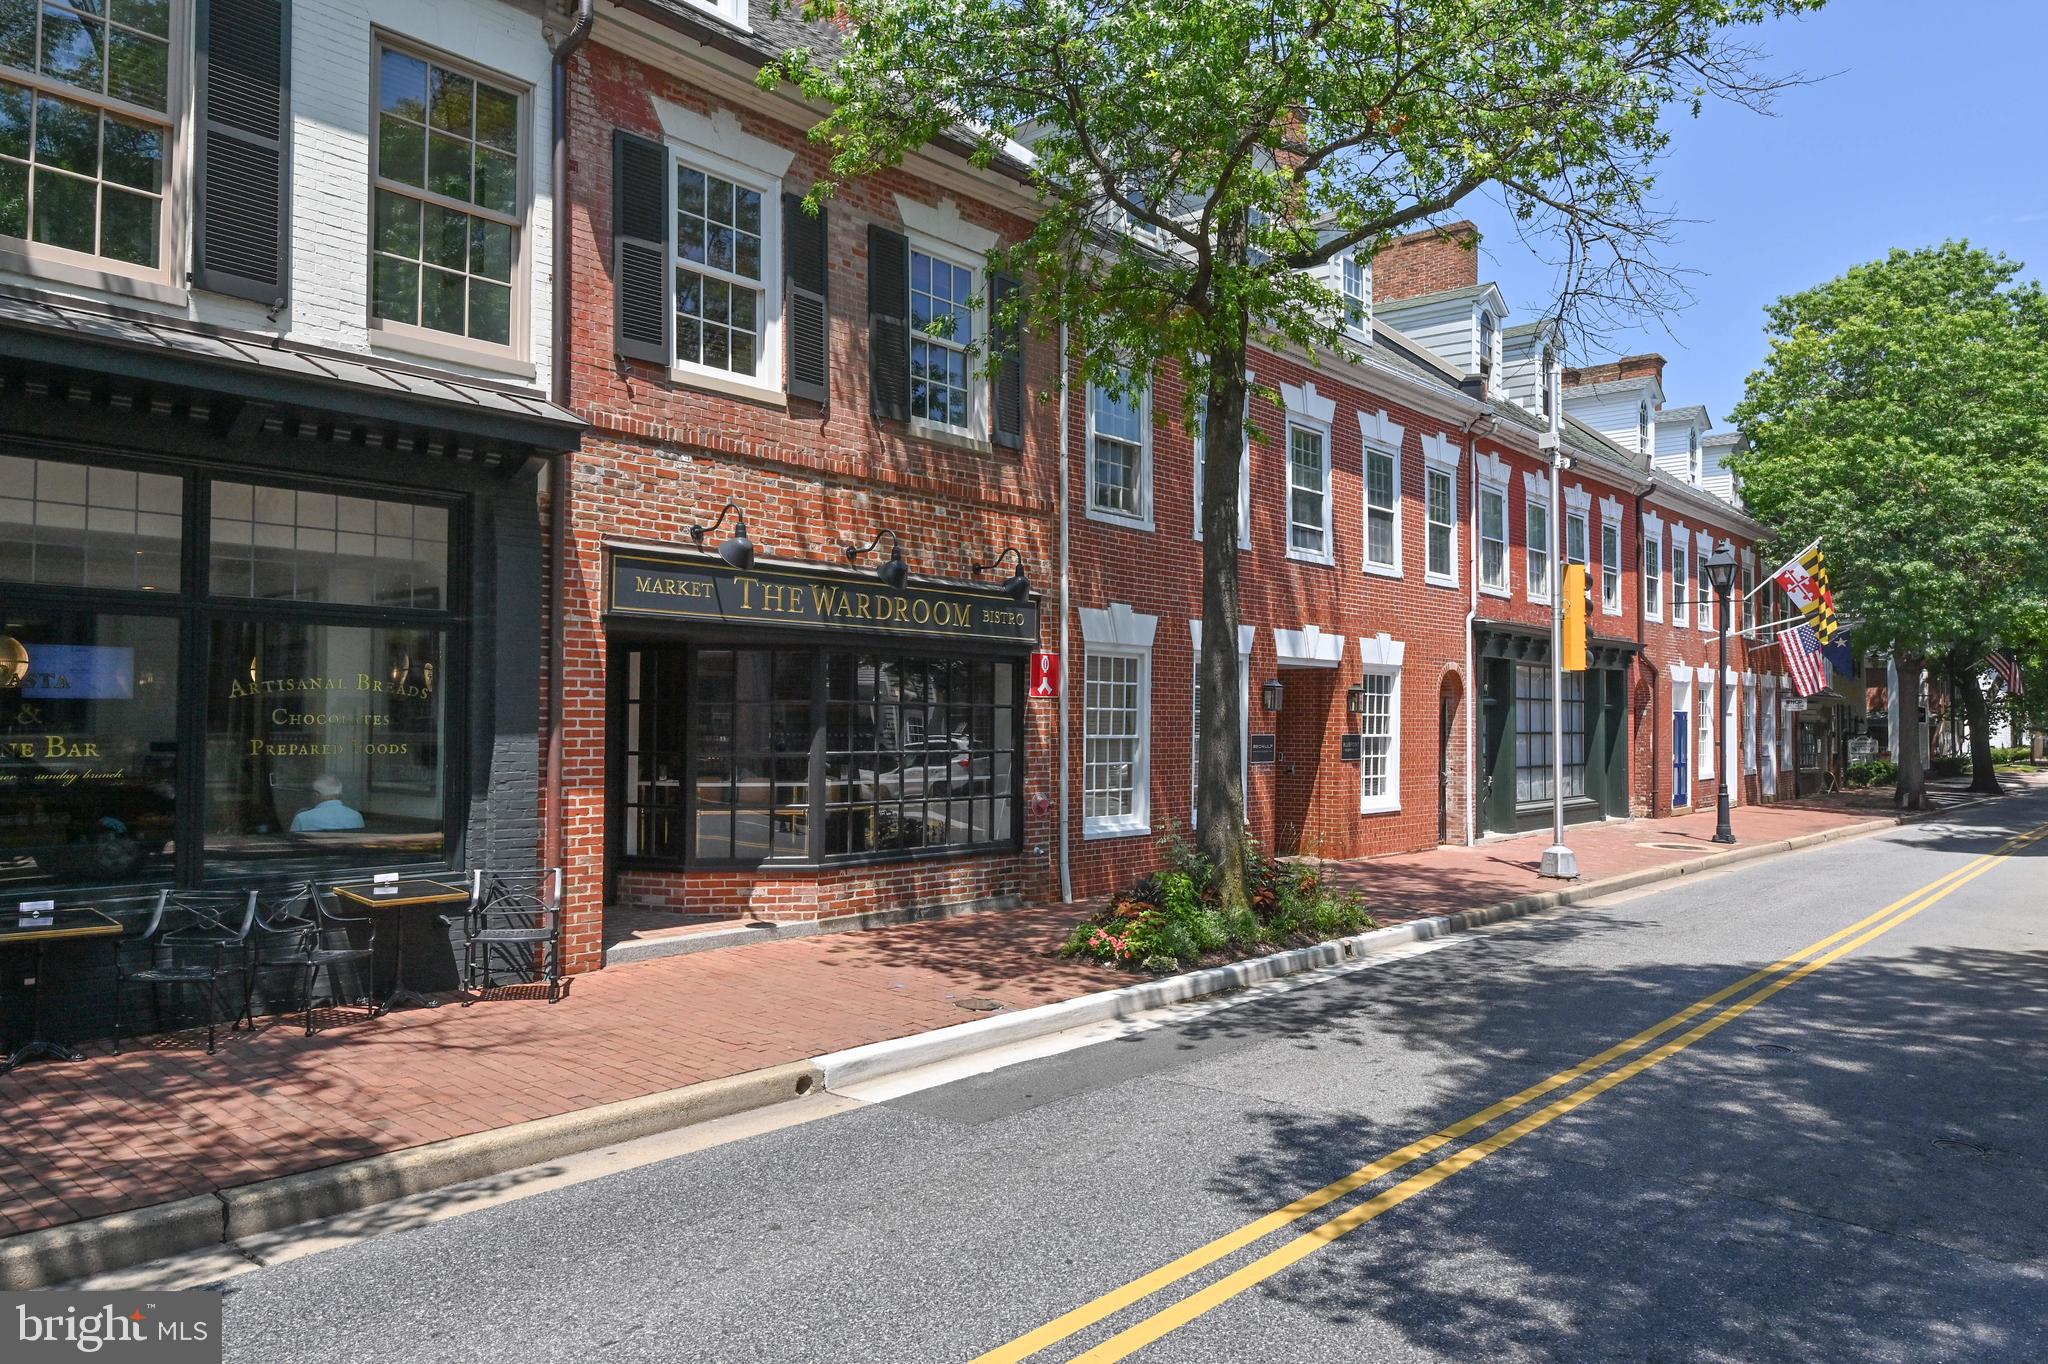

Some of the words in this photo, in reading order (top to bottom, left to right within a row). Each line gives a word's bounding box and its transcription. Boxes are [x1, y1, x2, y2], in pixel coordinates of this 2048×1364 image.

[635, 576, 714, 598] MARKET
[733, 575, 804, 614] THE
[808, 583, 973, 628] WARDROOM
[982, 609, 1025, 626] BISTRO
[228, 678, 346, 699] ARTISANAL
[356, 673, 430, 700] BREADS
[45, 735, 100, 758] BAR
[250, 739, 344, 756] PREPARED
[34, 768, 78, 787] sunday
